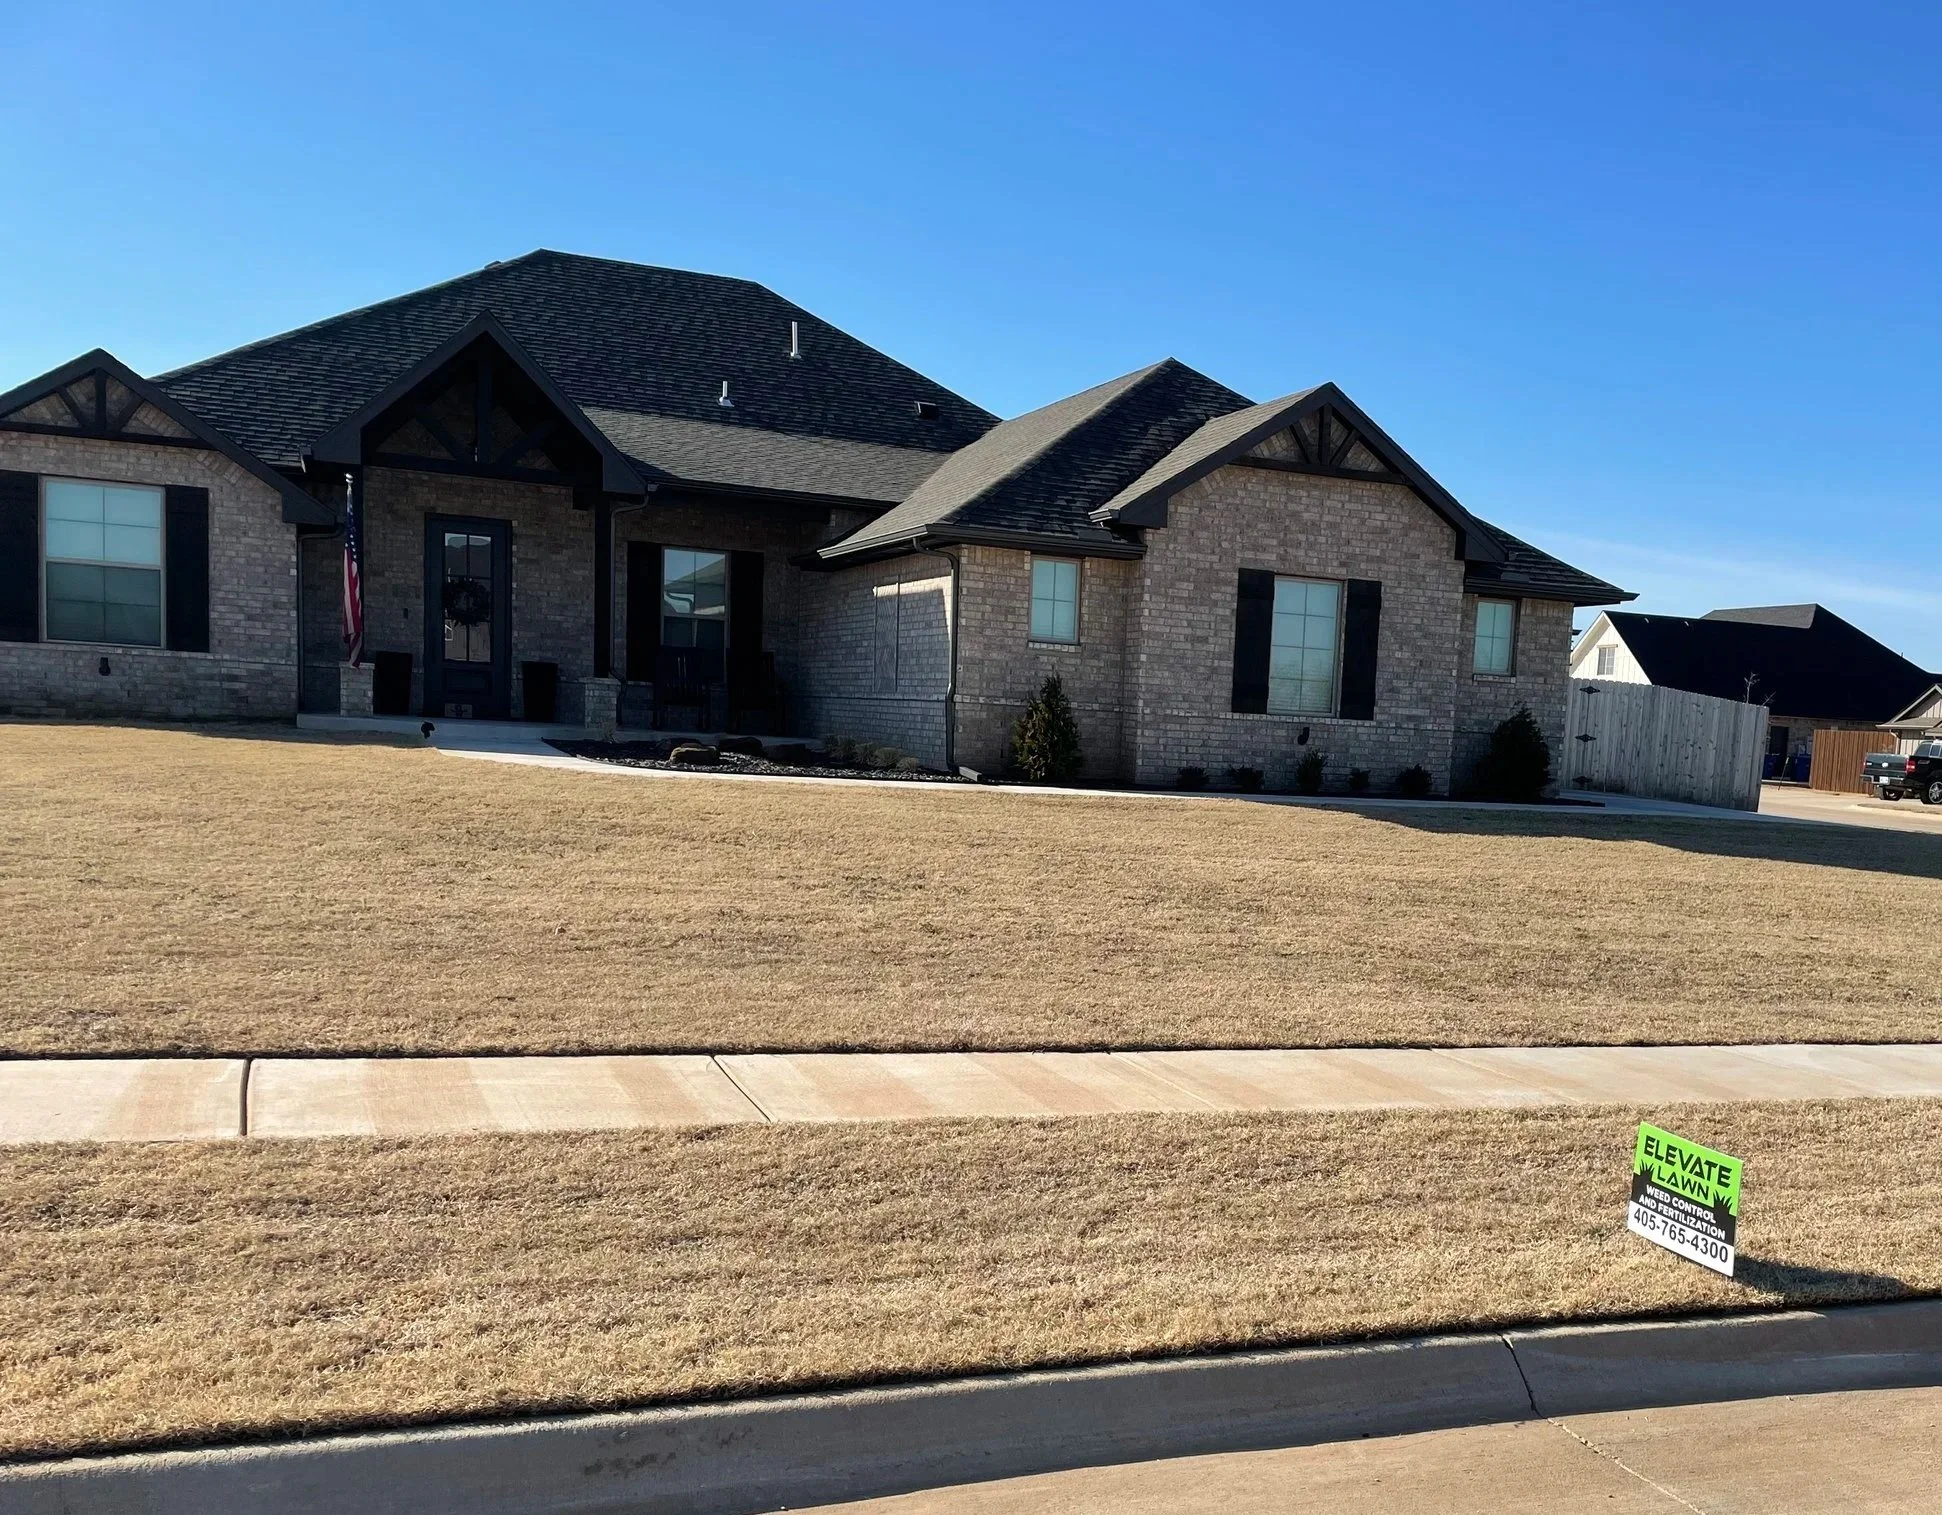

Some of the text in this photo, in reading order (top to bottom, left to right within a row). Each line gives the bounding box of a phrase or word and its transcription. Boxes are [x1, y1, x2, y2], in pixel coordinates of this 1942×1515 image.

[1643, 1135, 1732, 1188] ELEVATE
[1656, 1165, 1709, 1200] LAWN
[1638, 1194, 1726, 1241] AND FERTILIZATION
[1646, 1184, 1717, 1224] WEED CONTROL
[1633, 1207, 1728, 1263] 405-765-4300
